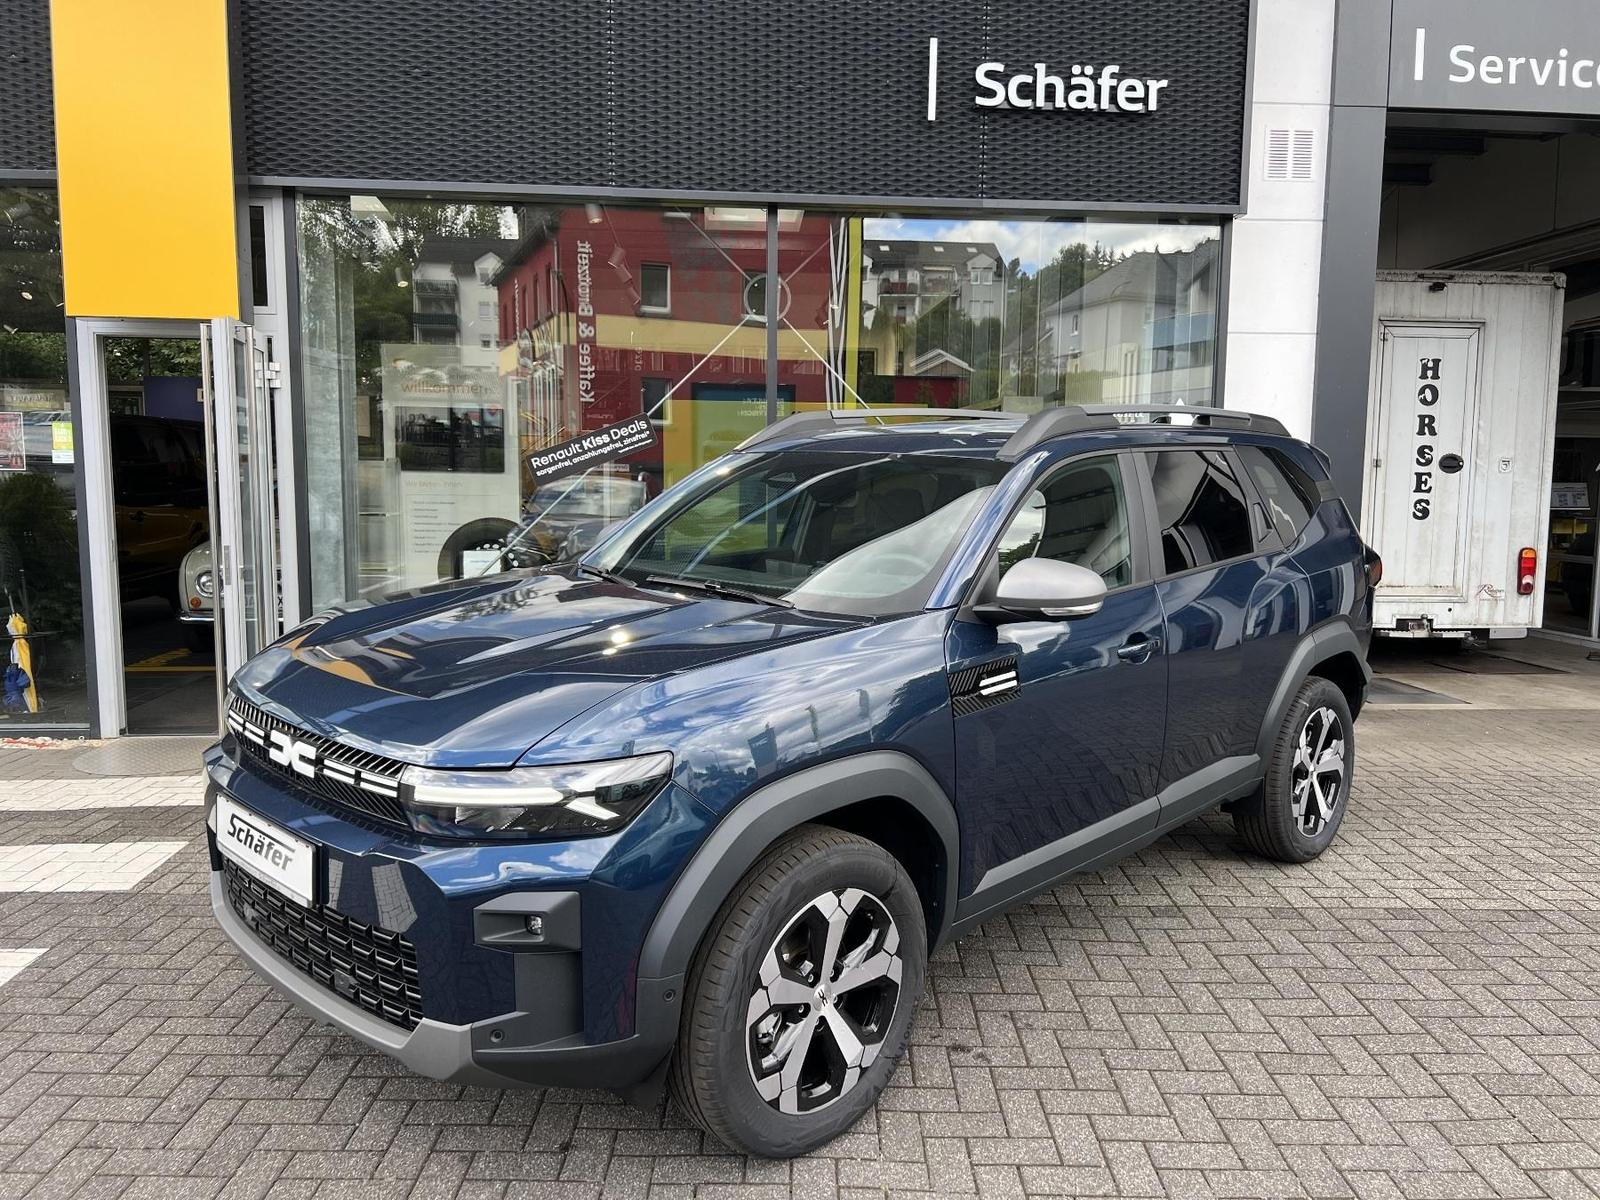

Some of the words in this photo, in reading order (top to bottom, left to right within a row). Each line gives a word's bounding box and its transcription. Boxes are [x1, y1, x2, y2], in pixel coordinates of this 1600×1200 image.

[975, 62, 1168, 111] Schäfer
[1448, 44, 1600, 88] Servic
[531, 442, 583, 469] Renault
[582, 434, 611, 451] Kiss
[610, 419, 648, 440] Deals
[1412, 357, 1442, 521] HORSES
[535, 459, 573, 477] sorgenfrei,
[227, 812, 293, 871] Schäfer
